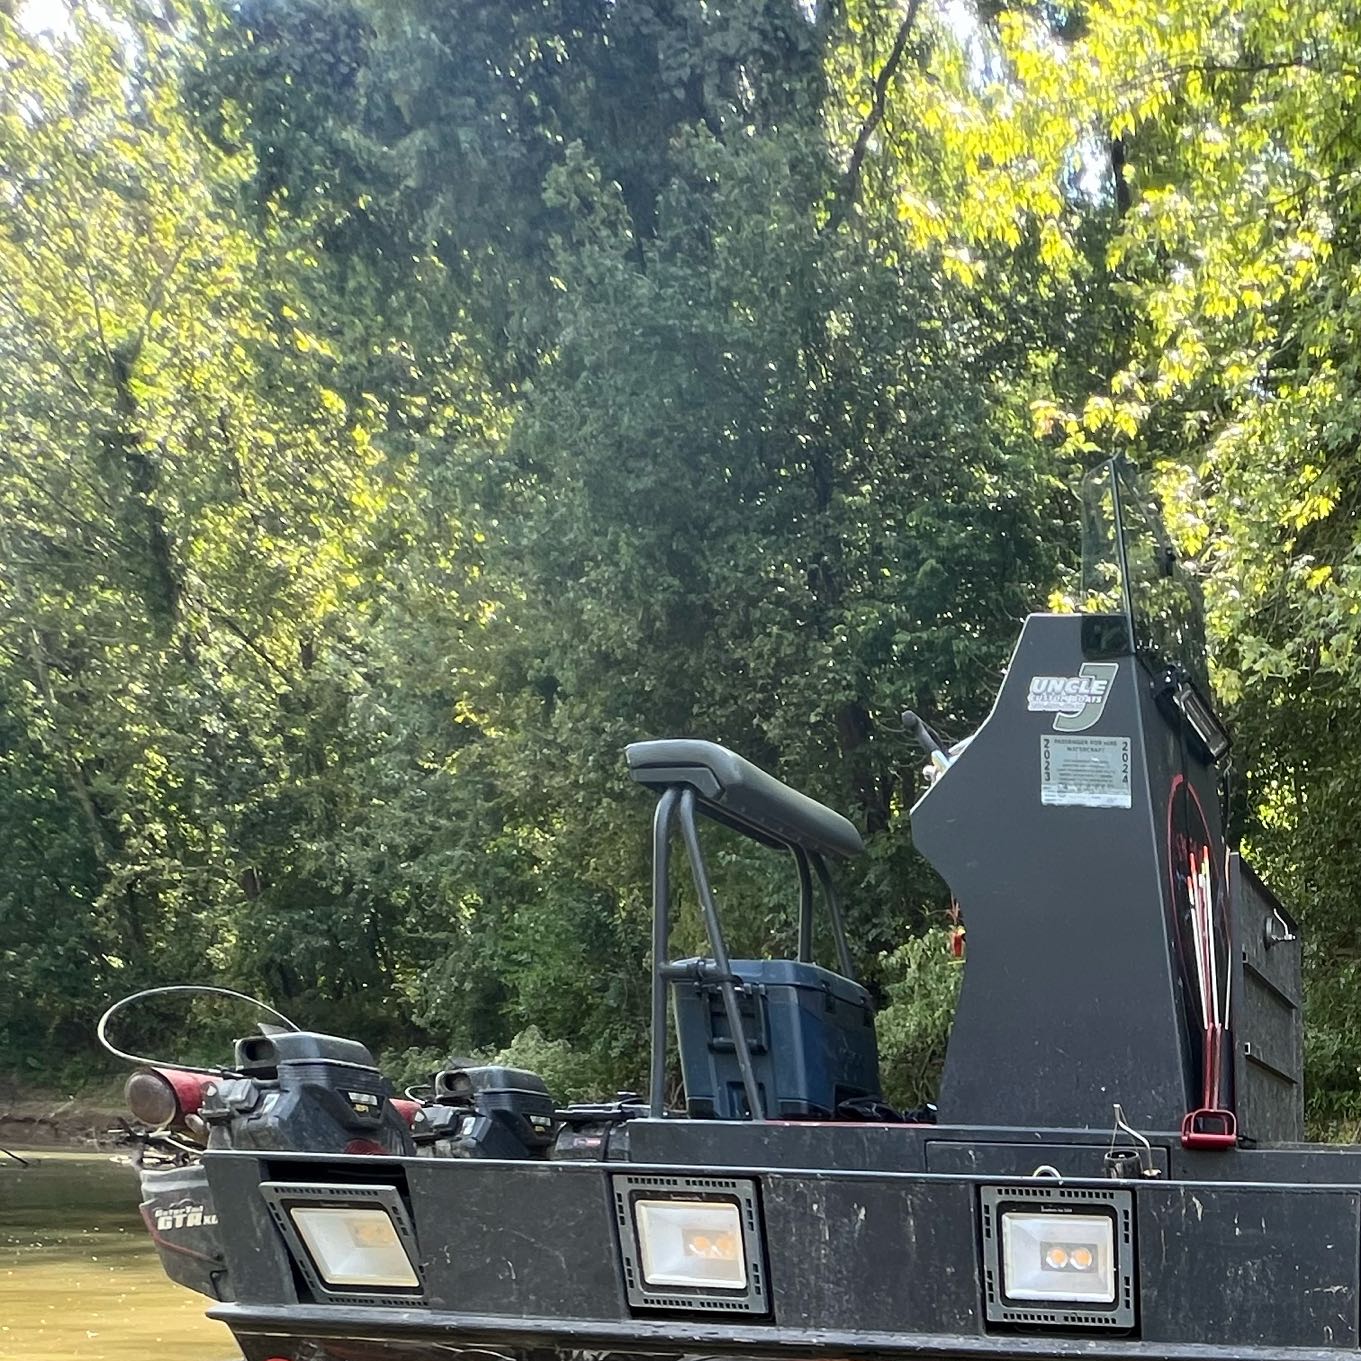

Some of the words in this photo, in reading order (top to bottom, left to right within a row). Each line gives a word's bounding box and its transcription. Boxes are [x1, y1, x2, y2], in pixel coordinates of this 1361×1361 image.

[1031, 679, 1107, 694] UNCLE
[1053, 662, 1119, 731] J
[1043, 738, 1051, 782] 2023
[1121, 741, 1129, 783] 2024
